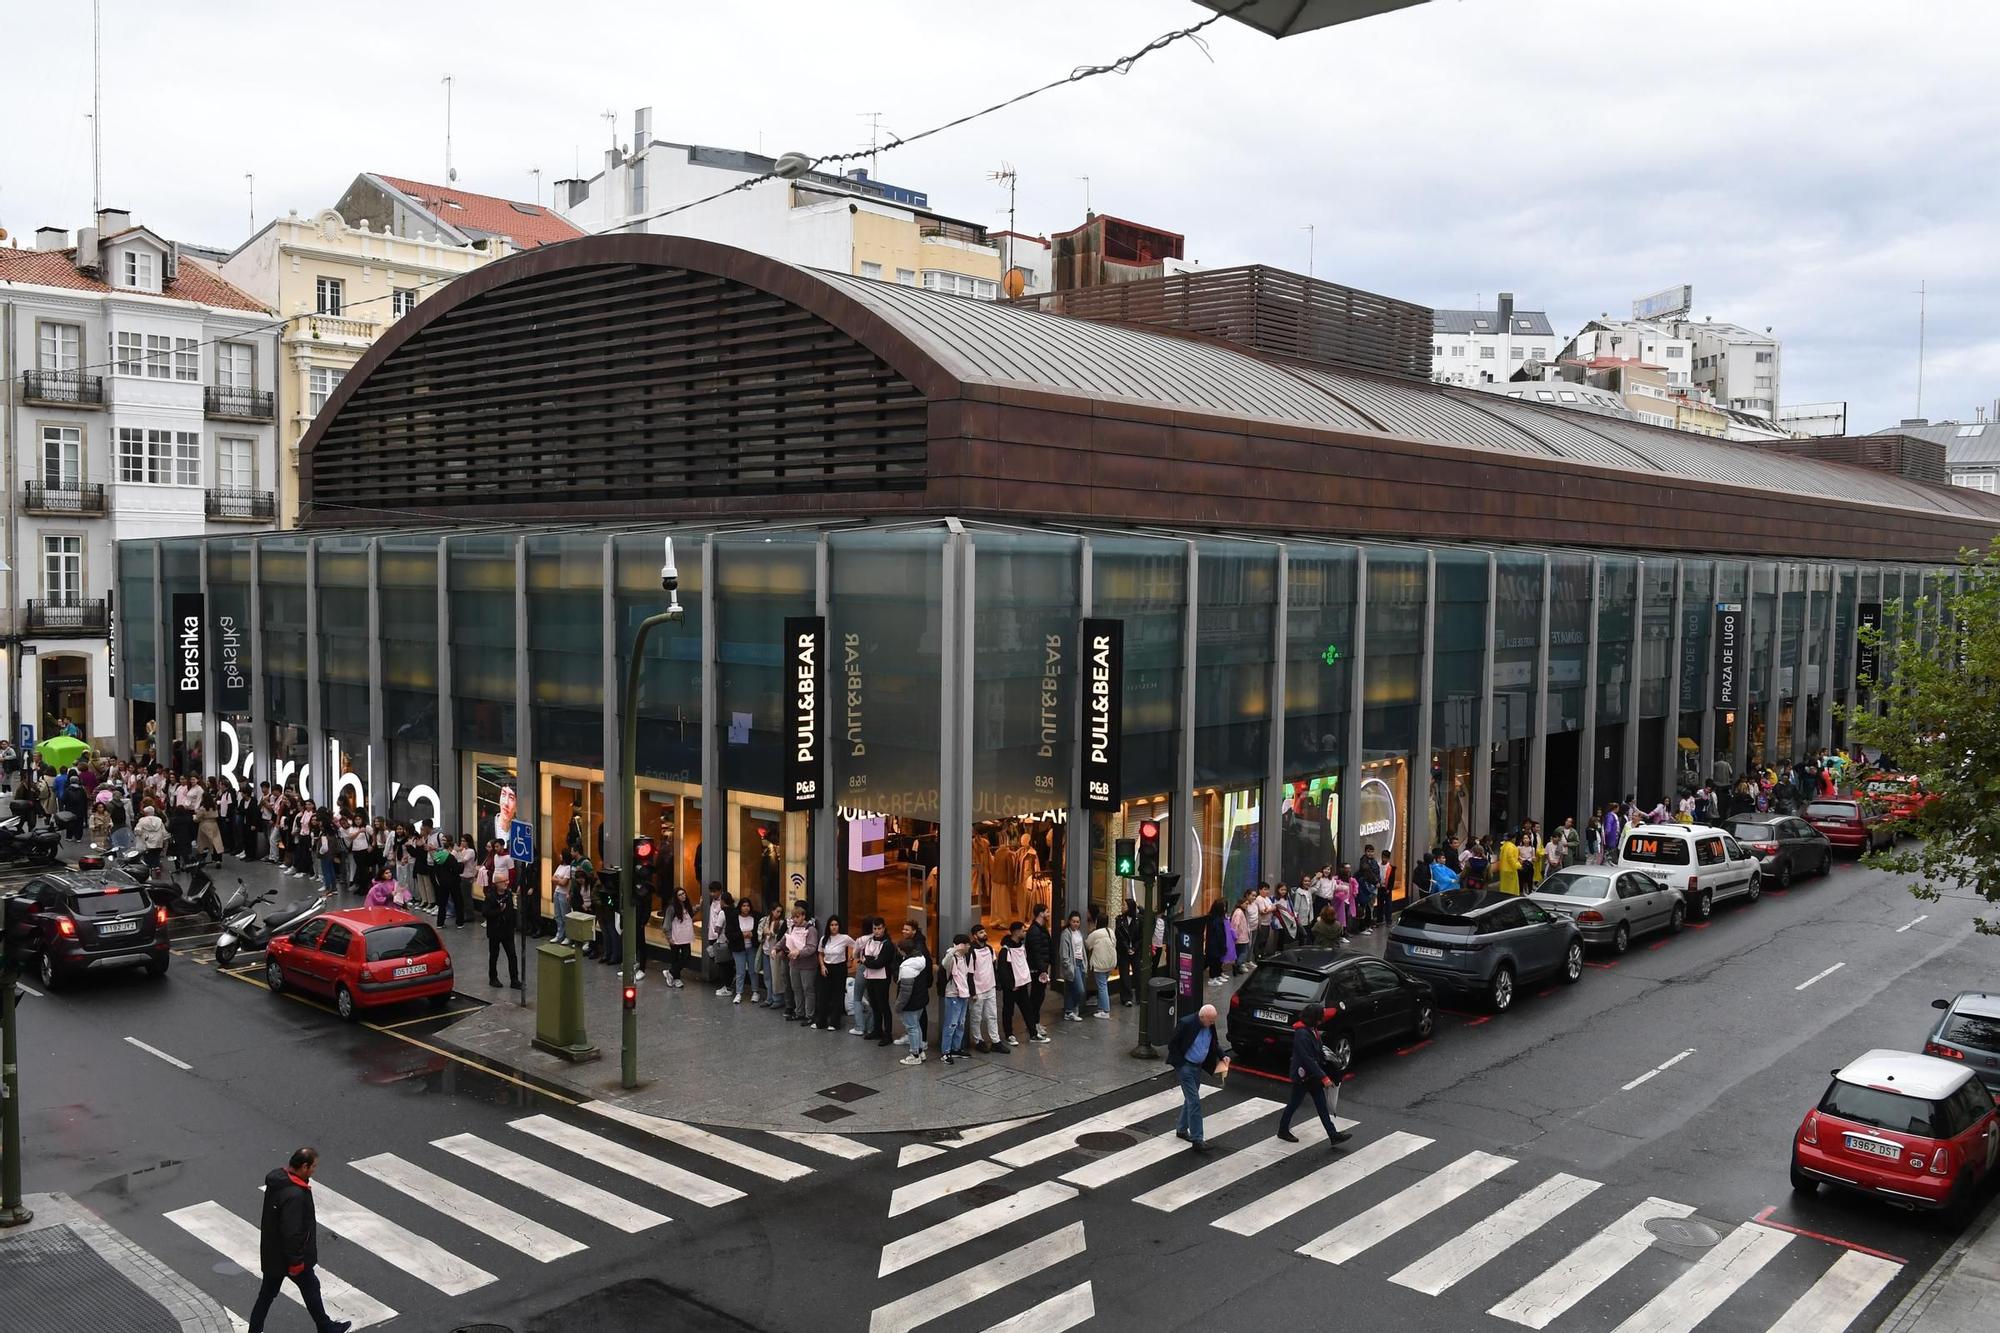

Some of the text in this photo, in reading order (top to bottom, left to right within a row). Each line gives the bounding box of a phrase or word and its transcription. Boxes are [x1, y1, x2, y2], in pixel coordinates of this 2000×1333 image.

[1724, 615, 1735, 646] LUGO
[180, 616, 199, 691] Bershka
[1723, 649, 1733, 663] DE
[1722, 666, 1733, 702] PRAZA
[798, 633, 815, 762] PULL&BEAR
[1091, 635, 1110, 763] PULL&BEAR
[21, 726, 30, 746] P
[796, 780, 816, 794] P&B
[1089, 781, 1109, 795] P&B
[1852, 1139, 1876, 1152] 3962
[1880, 1145, 1899, 1157] DST
